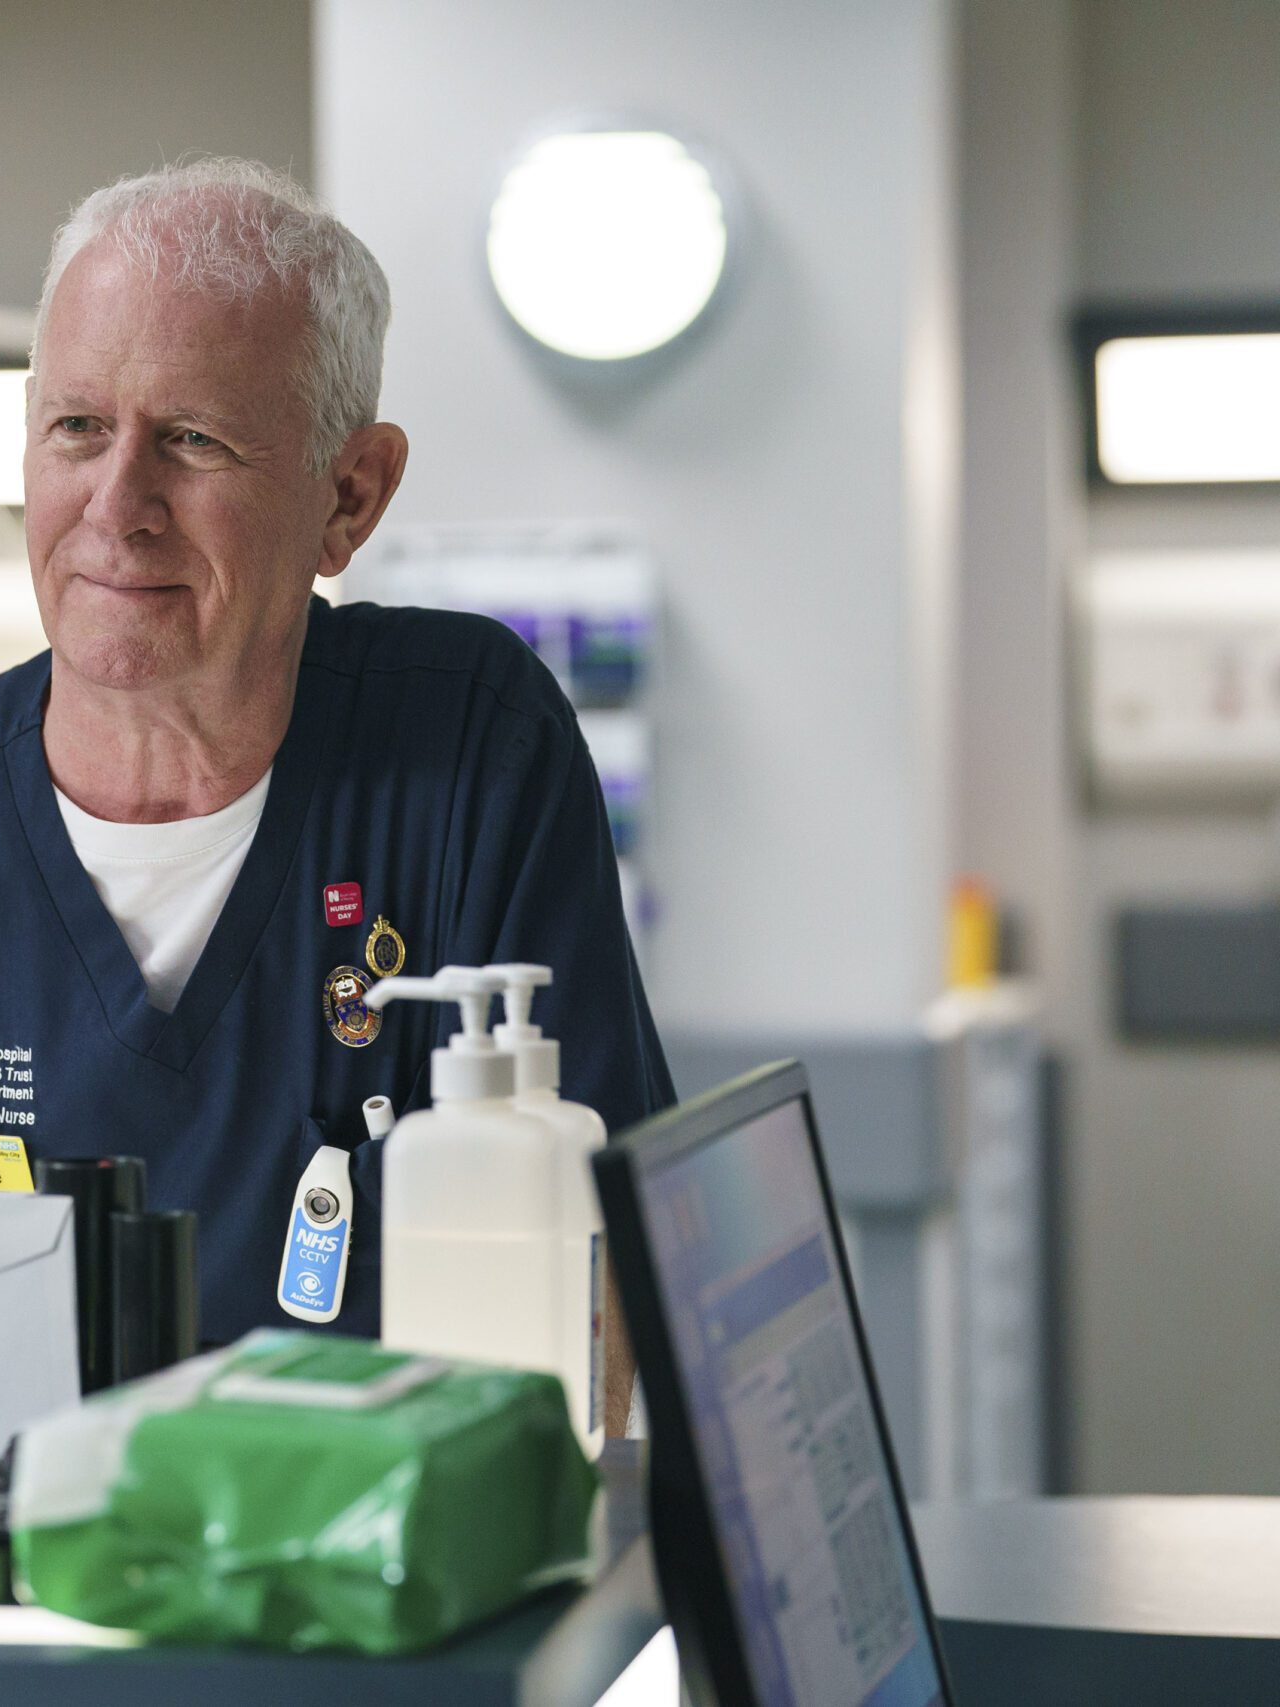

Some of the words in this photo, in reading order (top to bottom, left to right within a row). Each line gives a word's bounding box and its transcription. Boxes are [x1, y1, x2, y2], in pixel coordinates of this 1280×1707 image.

[337, 912, 352, 920] DAY
[5, 1066, 33, 1082] Trust
[0, 1141, 18, 1150] NHS
[296, 1228, 340, 1252] NHS
[299, 1248, 330, 1264] CCTV
